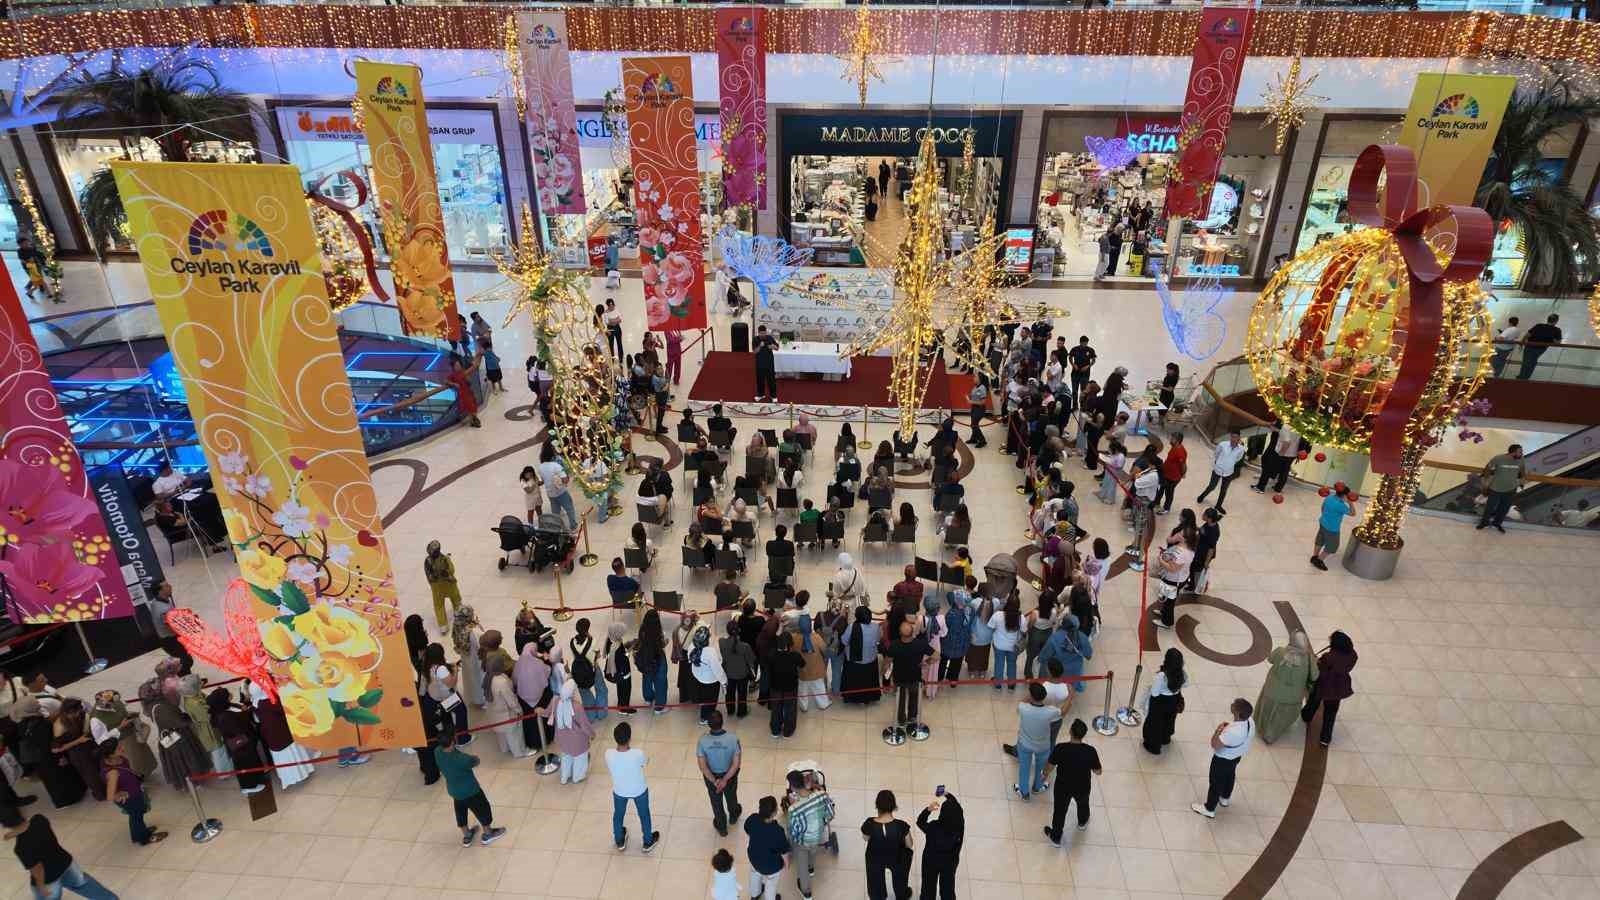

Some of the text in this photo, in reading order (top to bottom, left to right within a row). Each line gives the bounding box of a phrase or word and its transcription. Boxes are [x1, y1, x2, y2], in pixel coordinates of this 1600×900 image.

[428, 127, 476, 136] SAN GRUP
[1417, 118, 1488, 130] Ceylan Karavil
[820, 126, 977, 144] MADAME COCO
[1127, 133, 1178, 152] SCHA
[1437, 129, 1460, 139] Park
[171, 257, 301, 278] Ceylan Karavil
[219, 276, 261, 293] Park
